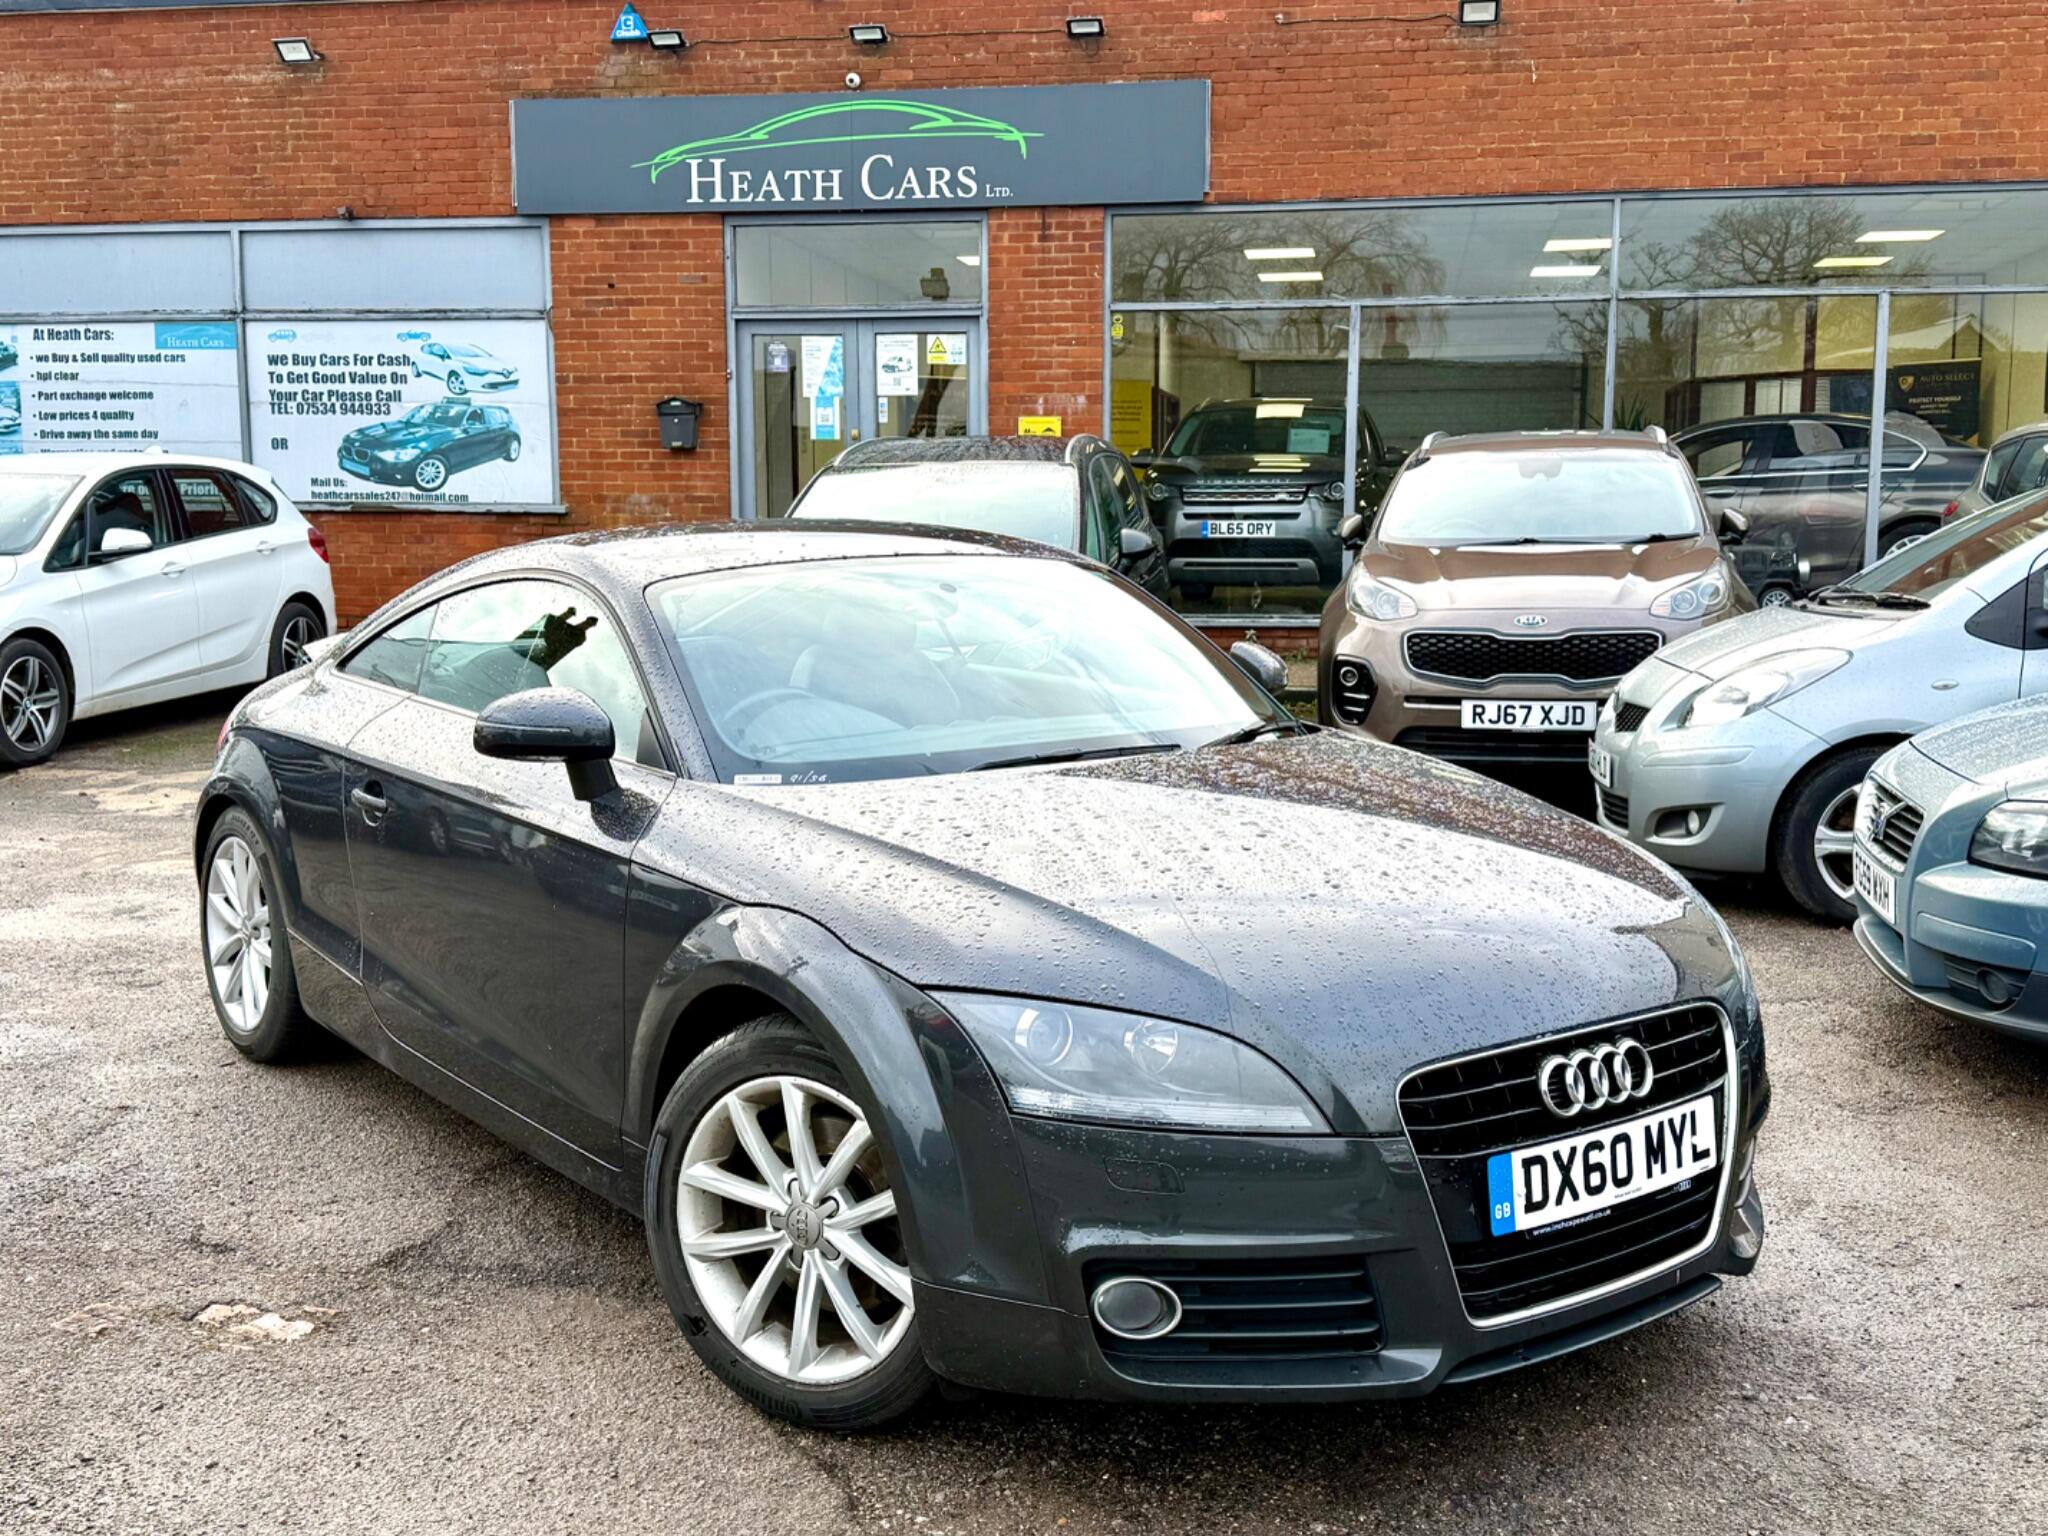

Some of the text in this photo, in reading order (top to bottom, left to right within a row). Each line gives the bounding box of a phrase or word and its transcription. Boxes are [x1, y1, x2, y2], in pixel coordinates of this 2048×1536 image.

[33, 327, 114, 341] At Heath Cars:
[51, 353, 70, 364] Buy
[72, 354, 79, 363] &
[80, 352, 100, 363] Sell
[101, 352, 136, 364] quality
[137, 353, 162, 363] used
[163, 354, 186, 363] cars
[292, 354, 317, 367] Buy
[320, 354, 350, 366] Cars
[353, 354, 374, 366] For
[377, 354, 411, 366] Cash
[54, 371, 80, 381] clear
[268, 371, 408, 384] To Get Good Value On
[38, 390, 154, 401] Part exchange welcome
[269, 389, 402, 403] Your Car Please Call
[270, 402, 391, 416] TEL: 07534 944933
[39, 410, 135, 422] Low prices 4 quality
[40, 429, 159, 440] Drive away the same day
[271, 437, 289, 450] OR
[310, 477, 348, 488] Mail Us:
[1209, 522, 1273, 535] BL65 ORY
[1472, 704, 1586, 726] RJ67 XJD
[1521, 1109, 1711, 1215] DX60 MYL
[1495, 1202, 1511, 1220] GB
